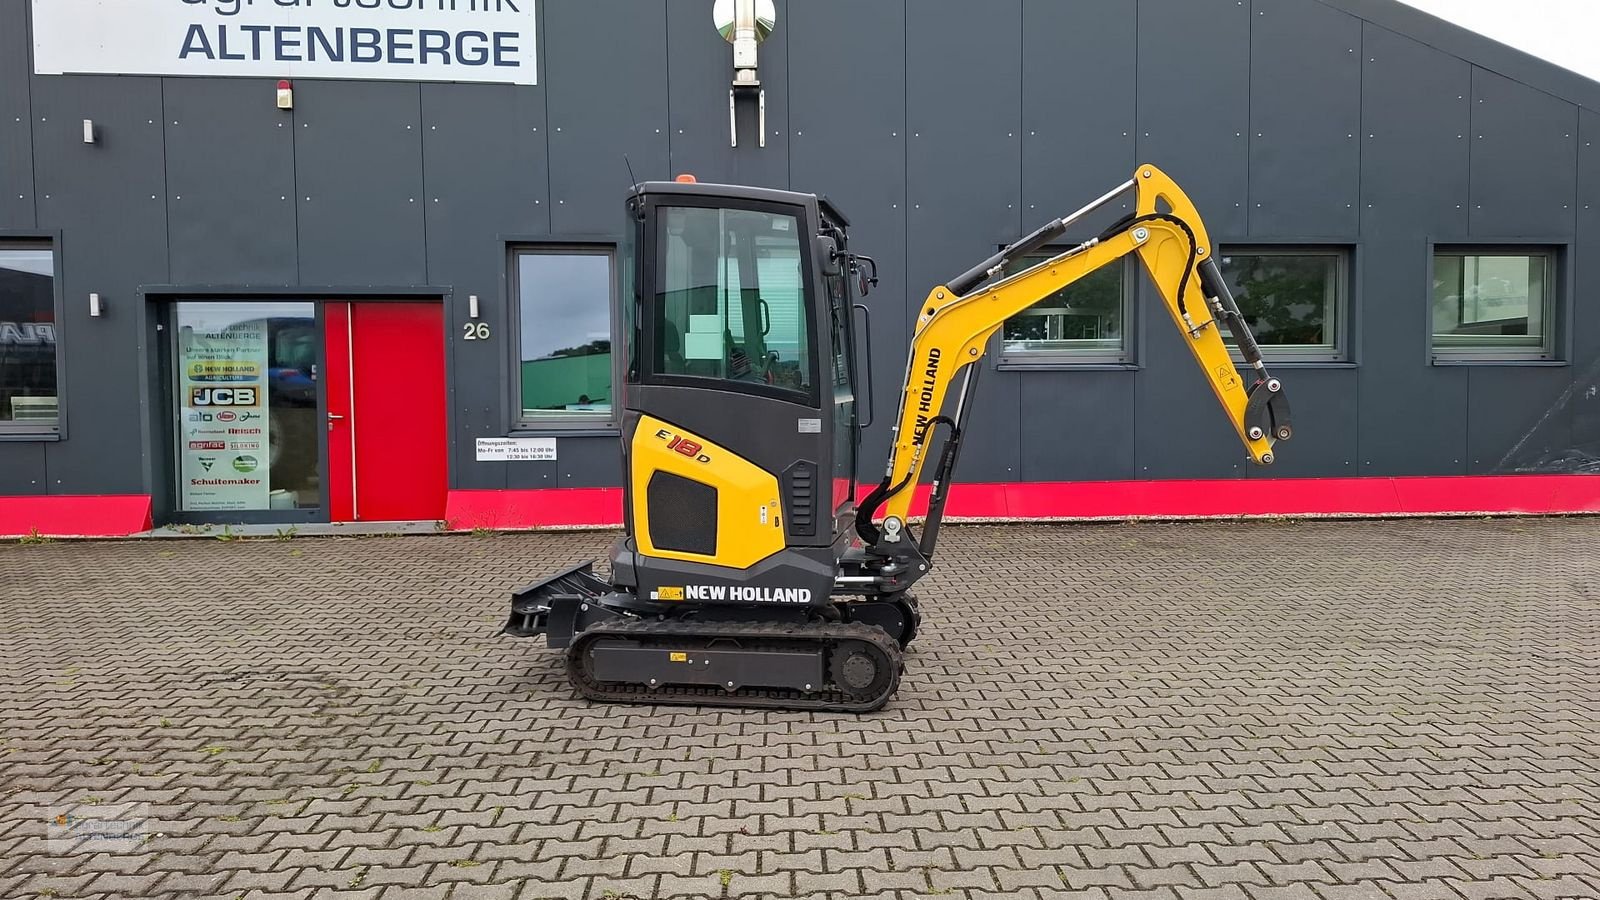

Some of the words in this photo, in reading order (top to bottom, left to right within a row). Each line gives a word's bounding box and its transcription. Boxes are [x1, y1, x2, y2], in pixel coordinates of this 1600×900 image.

[178, 24, 521, 67] ALTENBERGE
[205, 332, 261, 340] ALTENBERGE
[463, 322, 490, 340] 26
[919, 347, 941, 412] HOLLAND
[194, 388, 255, 405] JCB
[191, 477, 261, 486] Schuitemaker
[685, 585, 726, 600] NEW
[729, 586, 812, 603] HOLLAND
